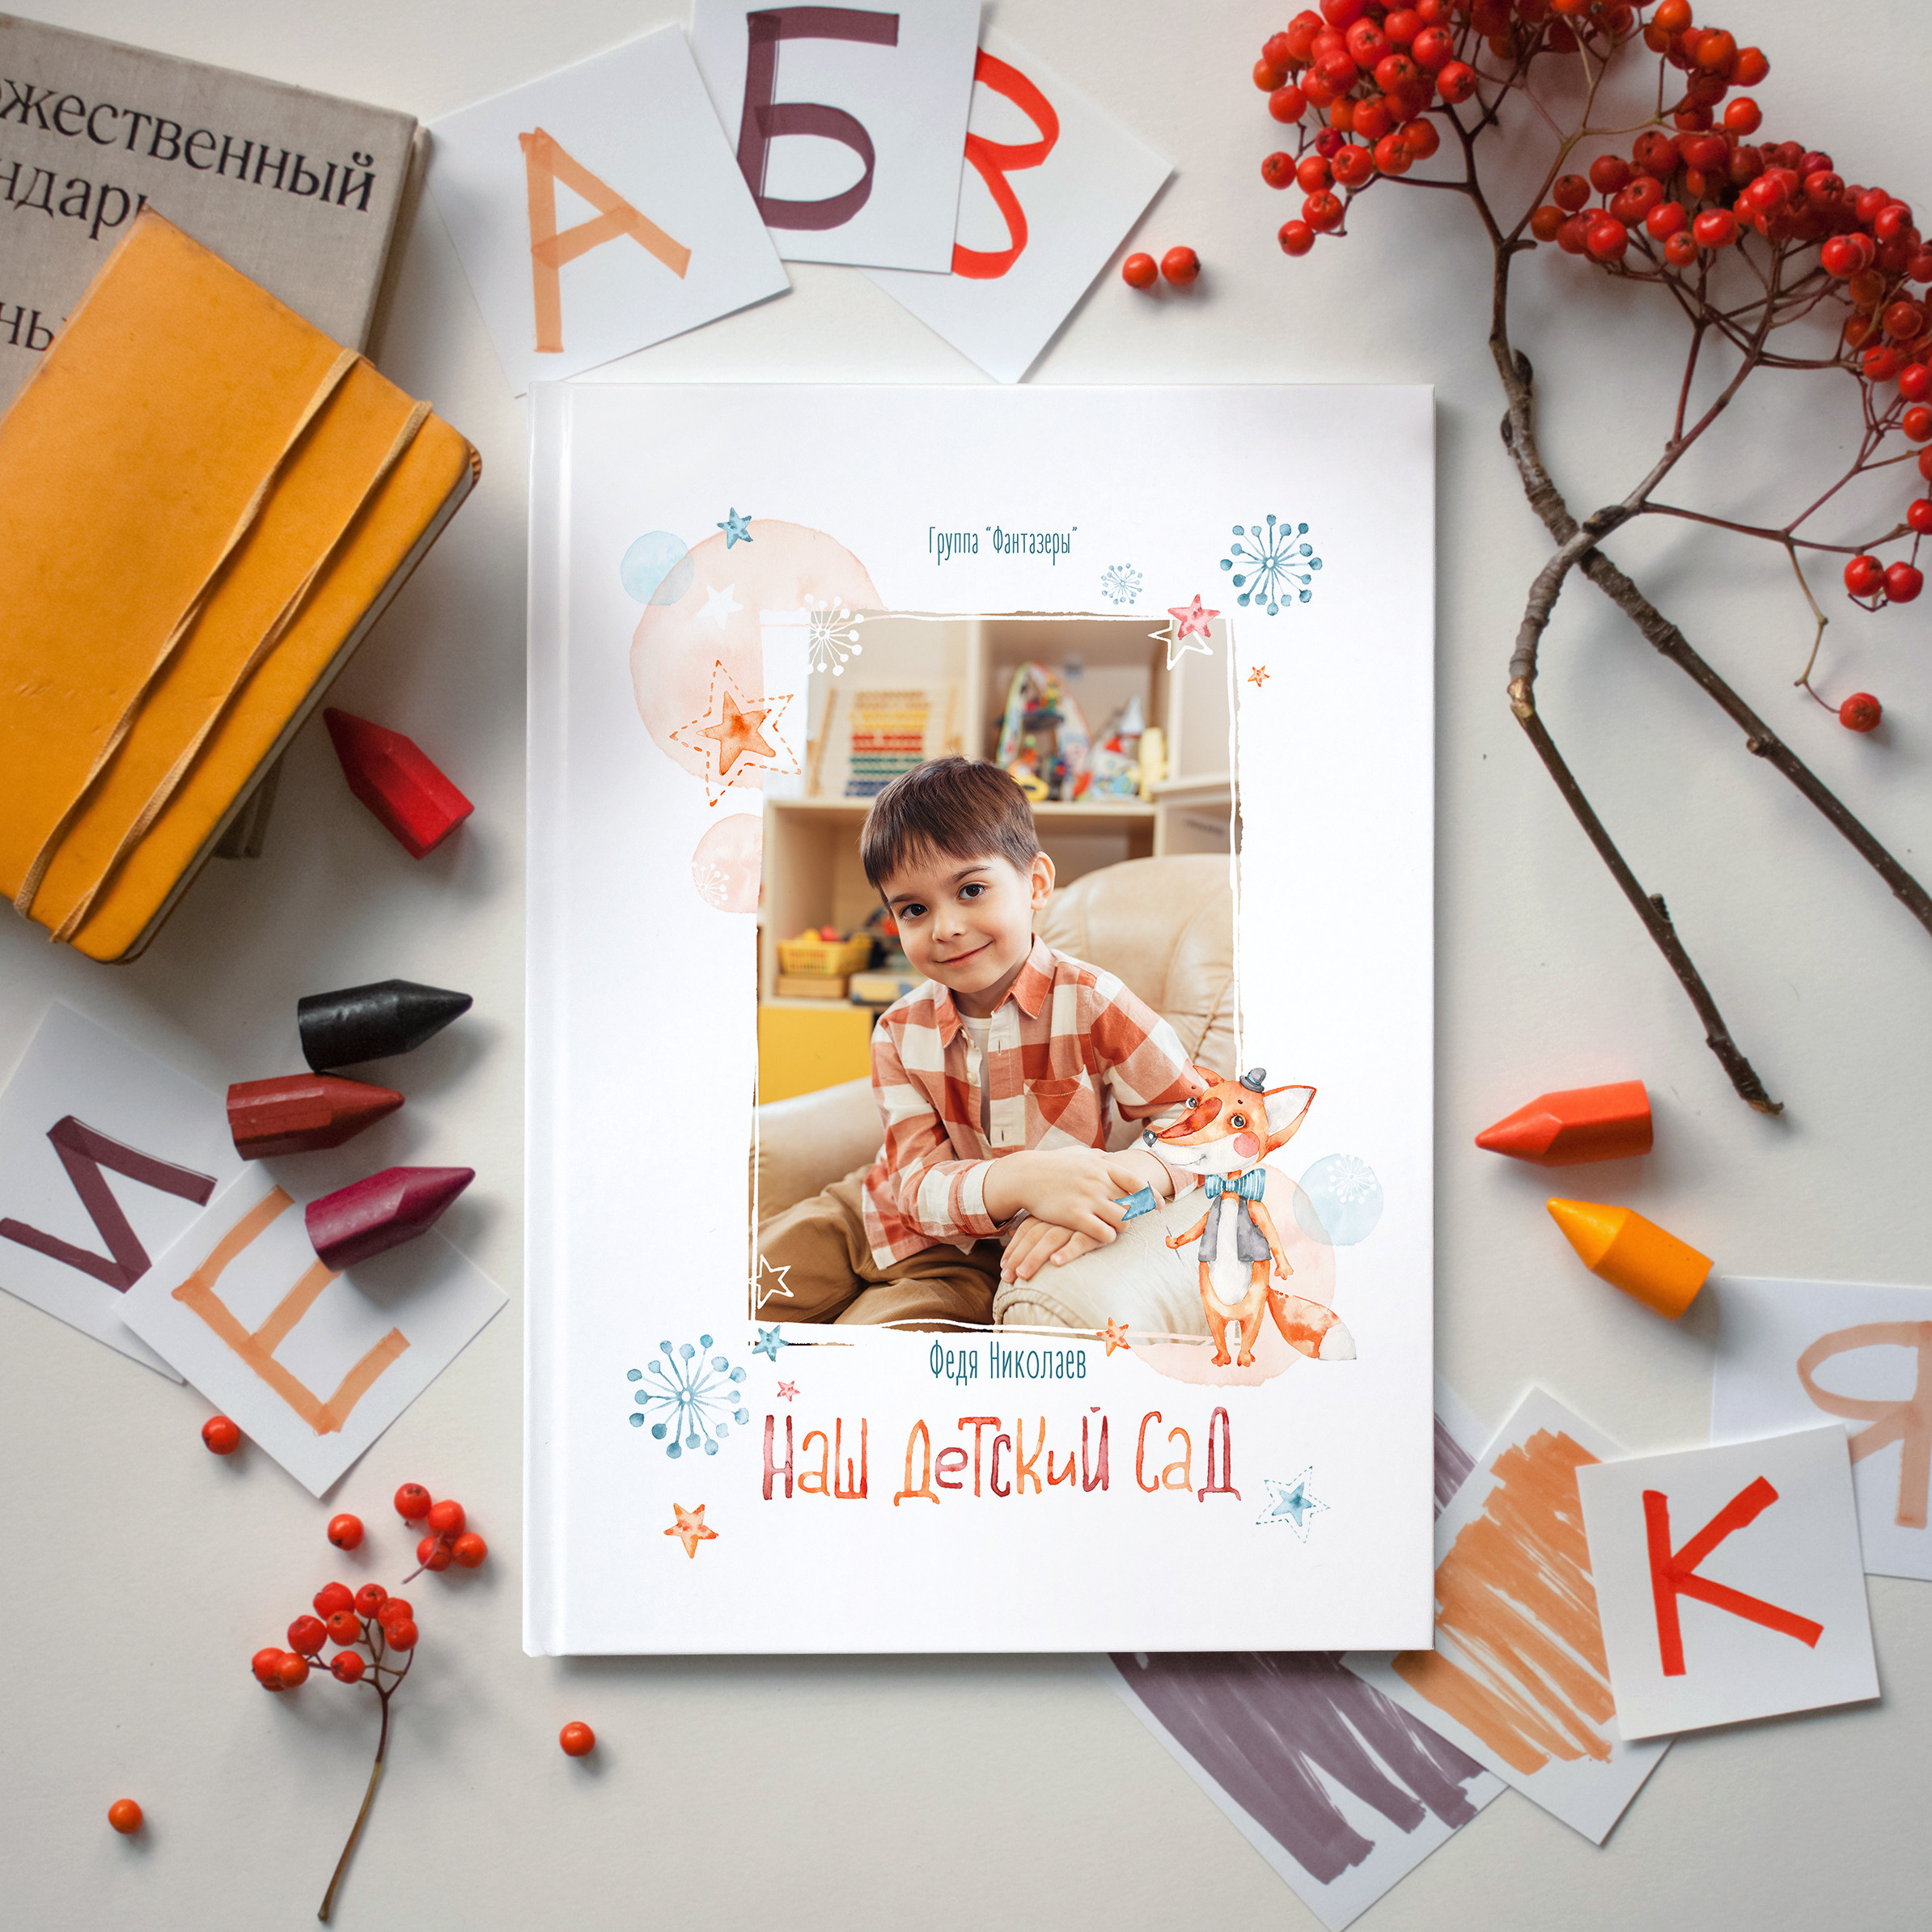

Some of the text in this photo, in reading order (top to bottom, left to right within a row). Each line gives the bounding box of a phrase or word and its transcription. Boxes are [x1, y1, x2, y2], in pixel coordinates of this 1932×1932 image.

[0, 78, 376, 213] жественный
[735, 6, 900, 231] Б
[518, 126, 692, 354] А
[929, 526, 978, 566] Группа
[930, 1339, 1087, 1386] Федя Николаев
[1642, 1475, 1824, 1677] К
